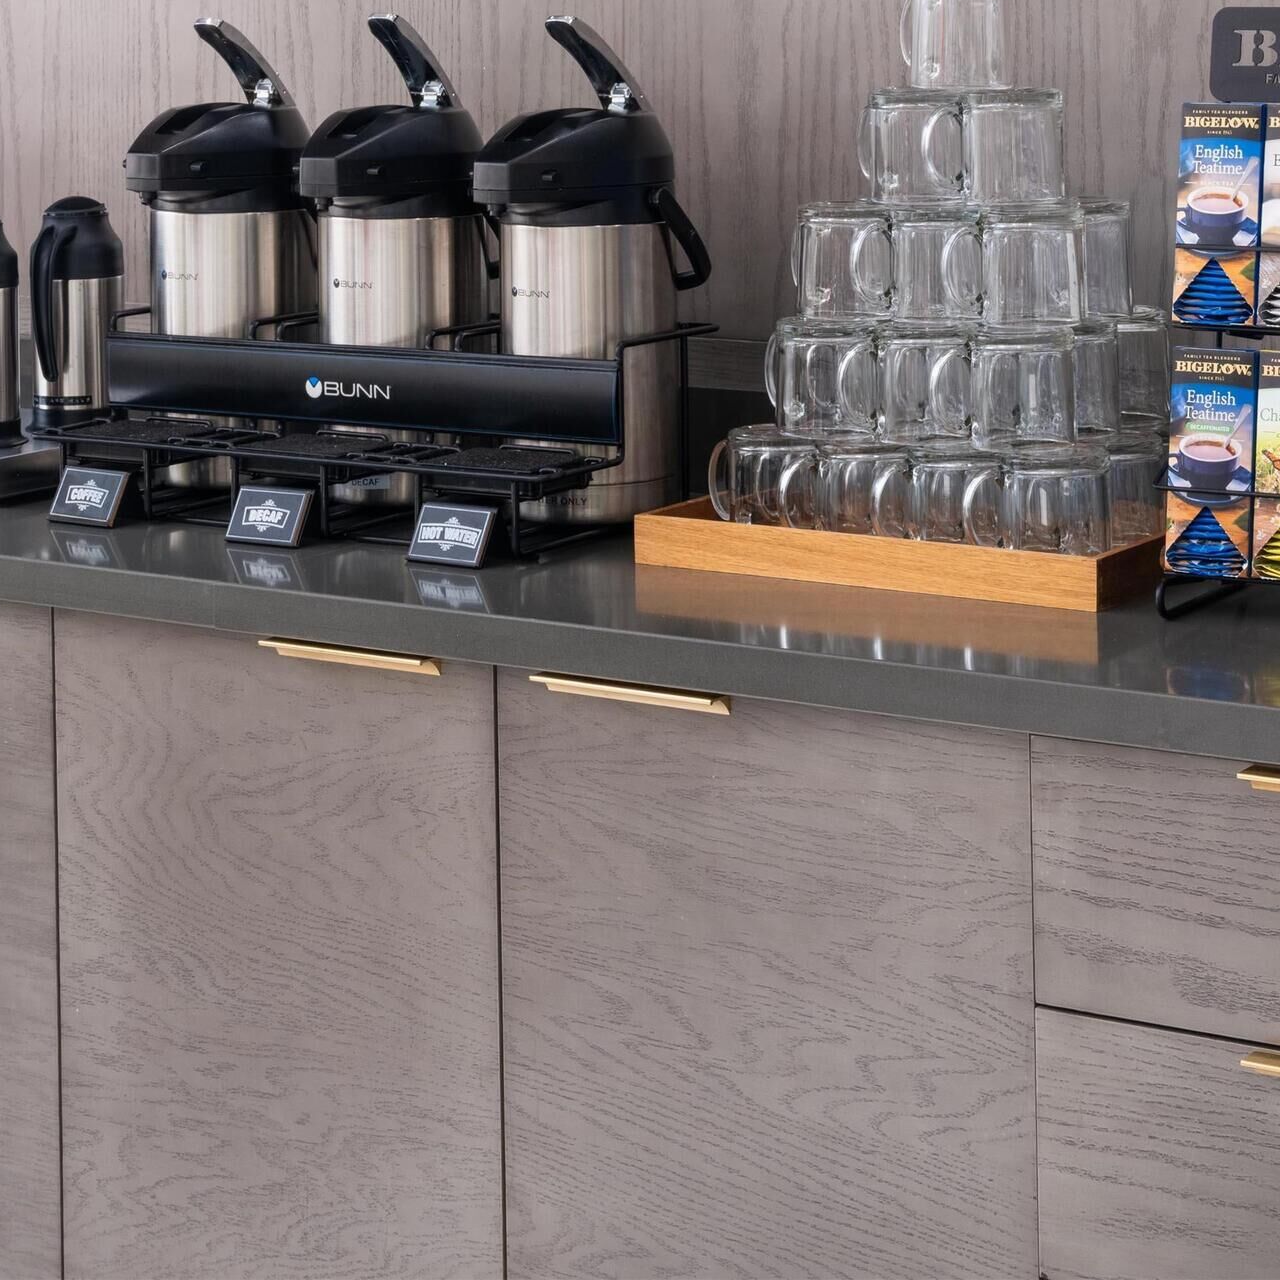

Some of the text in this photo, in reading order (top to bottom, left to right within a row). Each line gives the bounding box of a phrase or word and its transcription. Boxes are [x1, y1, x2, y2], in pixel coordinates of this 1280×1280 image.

[1183, 116, 1259, 129] BIGELOW
[1195, 144, 1244, 162] English
[340, 279, 373, 289] BUNN
[1174, 360, 1252, 377] BIGELOW
[323, 381, 390, 400] BUNN
[1186, 389, 1236, 409] English
[70, 488, 104, 503] COFFEE
[560, 496, 588, 506] ONLY
[248, 509, 284, 524] DECAF
[421, 526, 478, 545] HOT WATER
